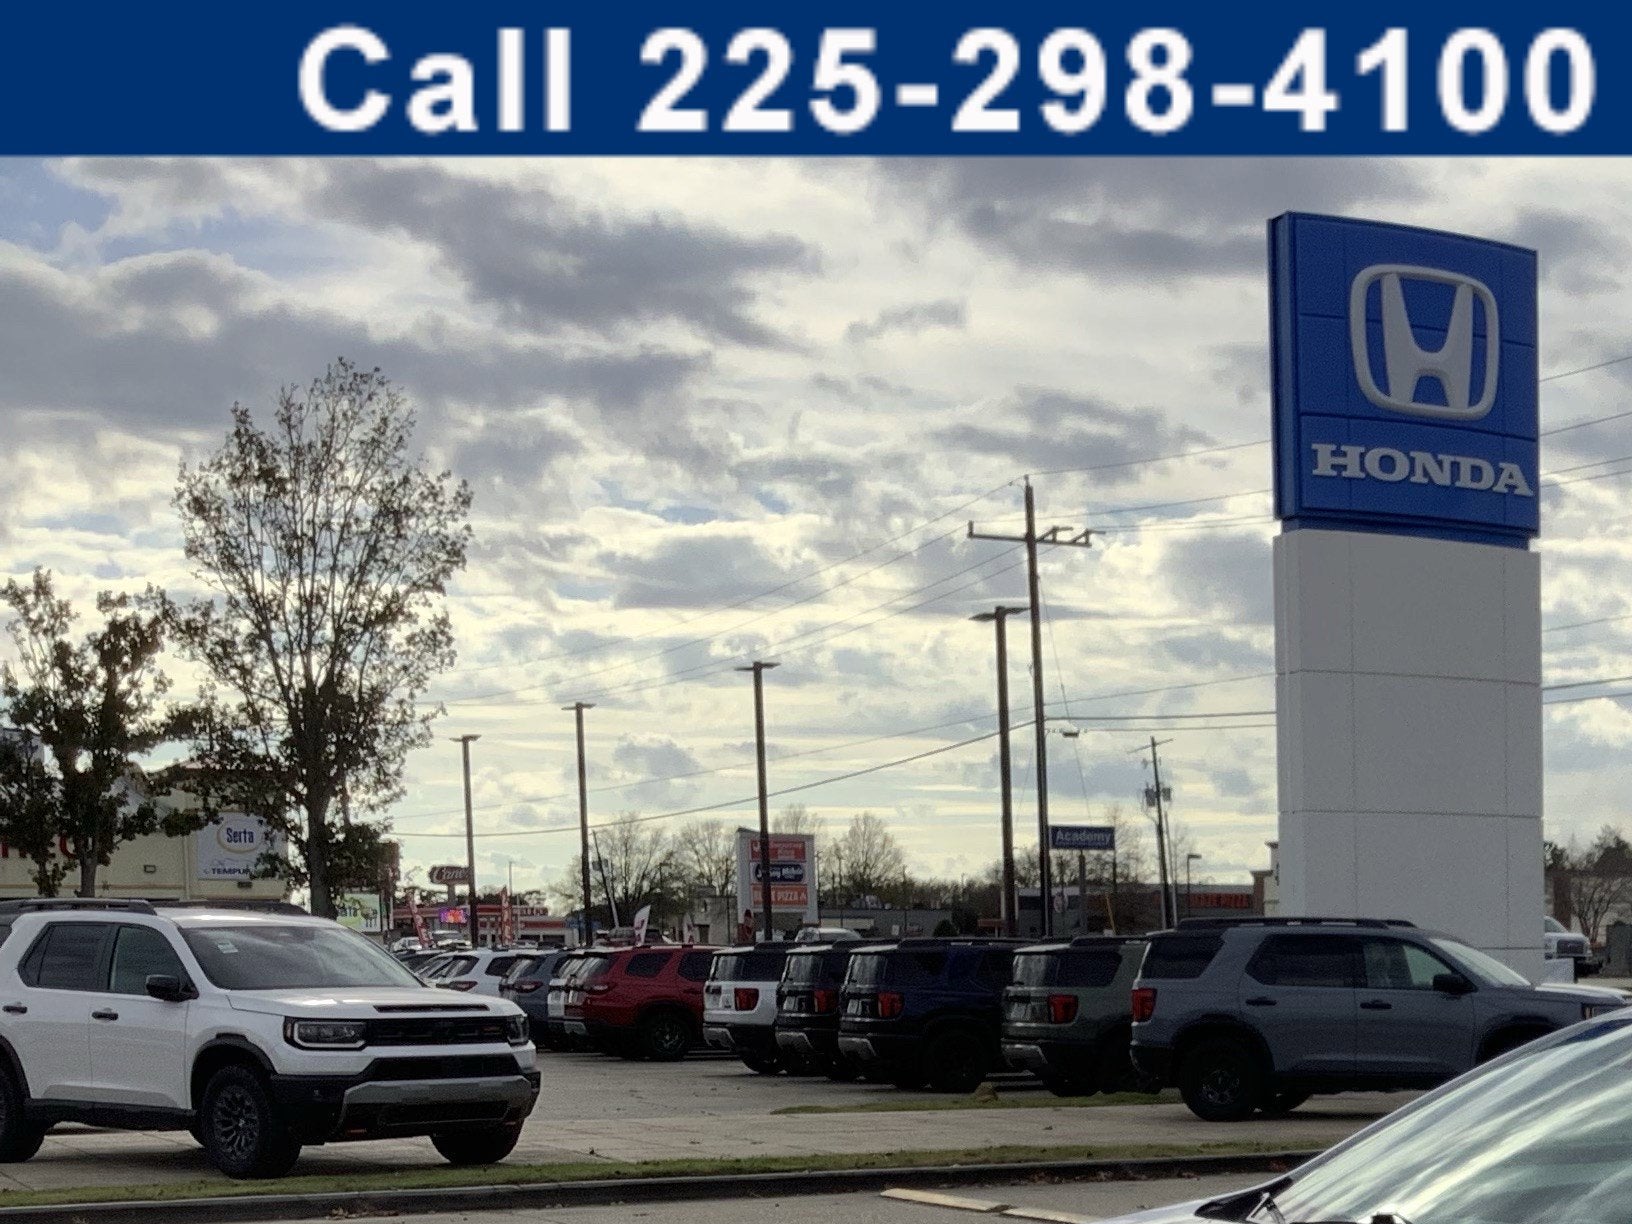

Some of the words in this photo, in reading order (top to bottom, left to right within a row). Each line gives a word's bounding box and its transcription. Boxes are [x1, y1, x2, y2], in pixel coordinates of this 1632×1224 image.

[1311, 443, 1534, 497] HONDA
[226, 827, 255, 843] Serta
[1056, 829, 1111, 845] Academy
